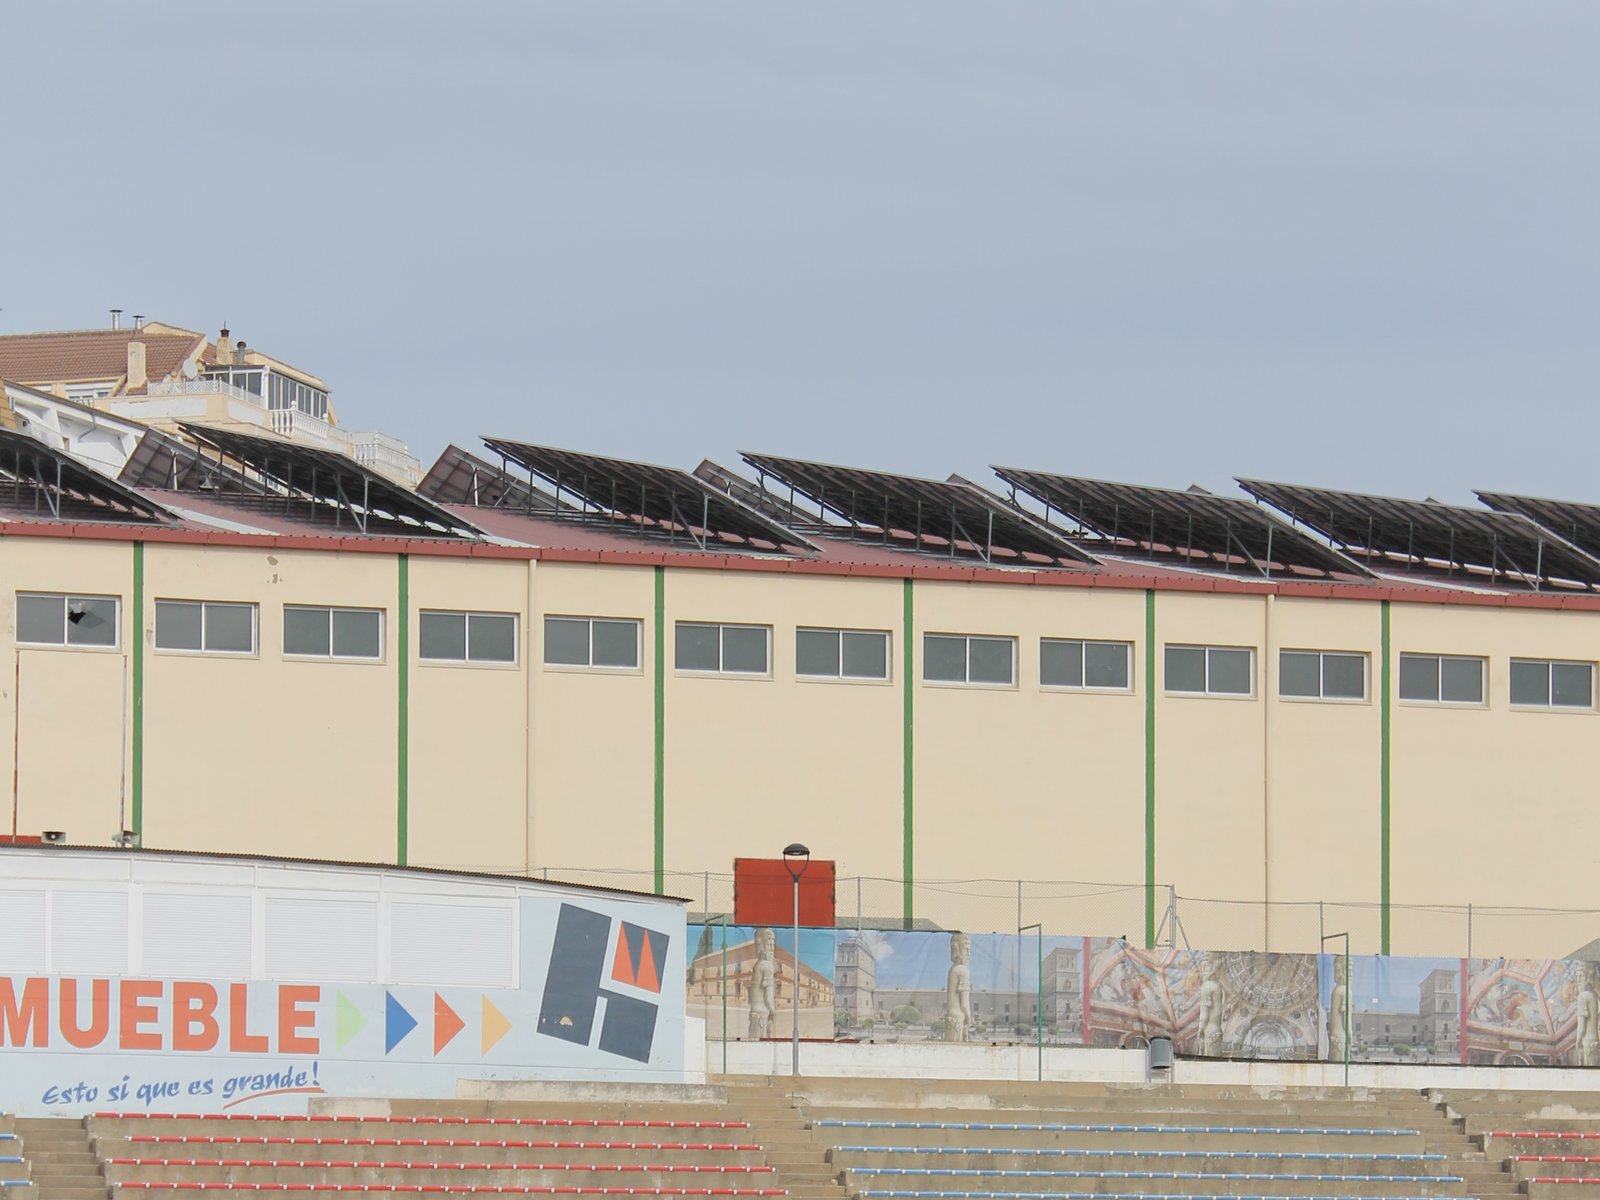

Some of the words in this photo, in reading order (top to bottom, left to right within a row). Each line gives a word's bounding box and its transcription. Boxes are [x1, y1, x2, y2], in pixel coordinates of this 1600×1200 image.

[0, 977, 320, 1054] MUEBLE
[42, 1082, 98, 1105] Esto
[136, 1082, 179, 1106] que
[188, 1078, 214, 1096] es
[222, 1061, 320, 1099] grande!
